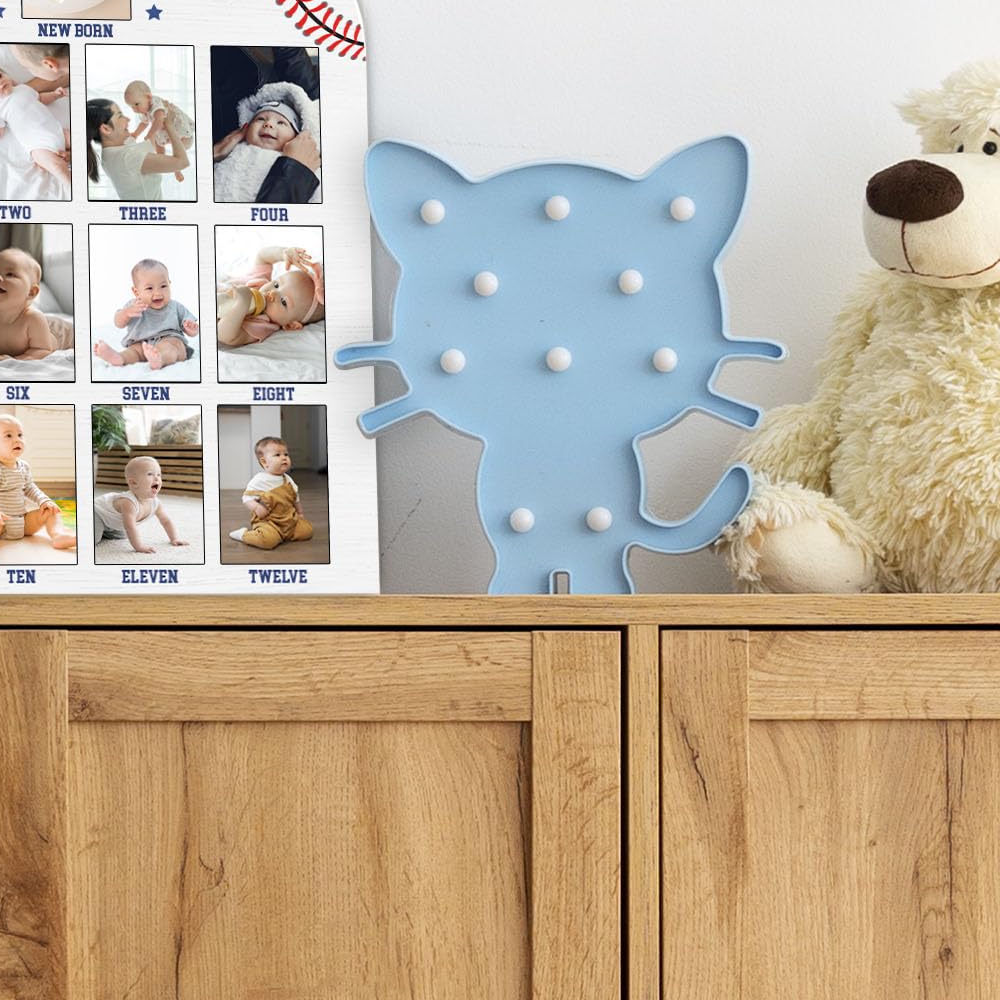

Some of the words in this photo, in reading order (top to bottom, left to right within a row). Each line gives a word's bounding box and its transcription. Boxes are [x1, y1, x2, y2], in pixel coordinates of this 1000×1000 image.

[37, 23, 72, 37] NEW
[74, 23, 113, 38] BORN
[0, 205, 31, 220] TWO
[119, 206, 166, 221] THREE
[251, 207, 288, 222] FOUR
[6, 385, 30, 401] SIX
[122, 386, 170, 401] SEVEN
[253, 386, 295, 401] EIGHT
[7, 569, 36, 584] TEN
[122, 569, 178, 584] ELEVEN
[249, 569, 307, 584] TWELVE
